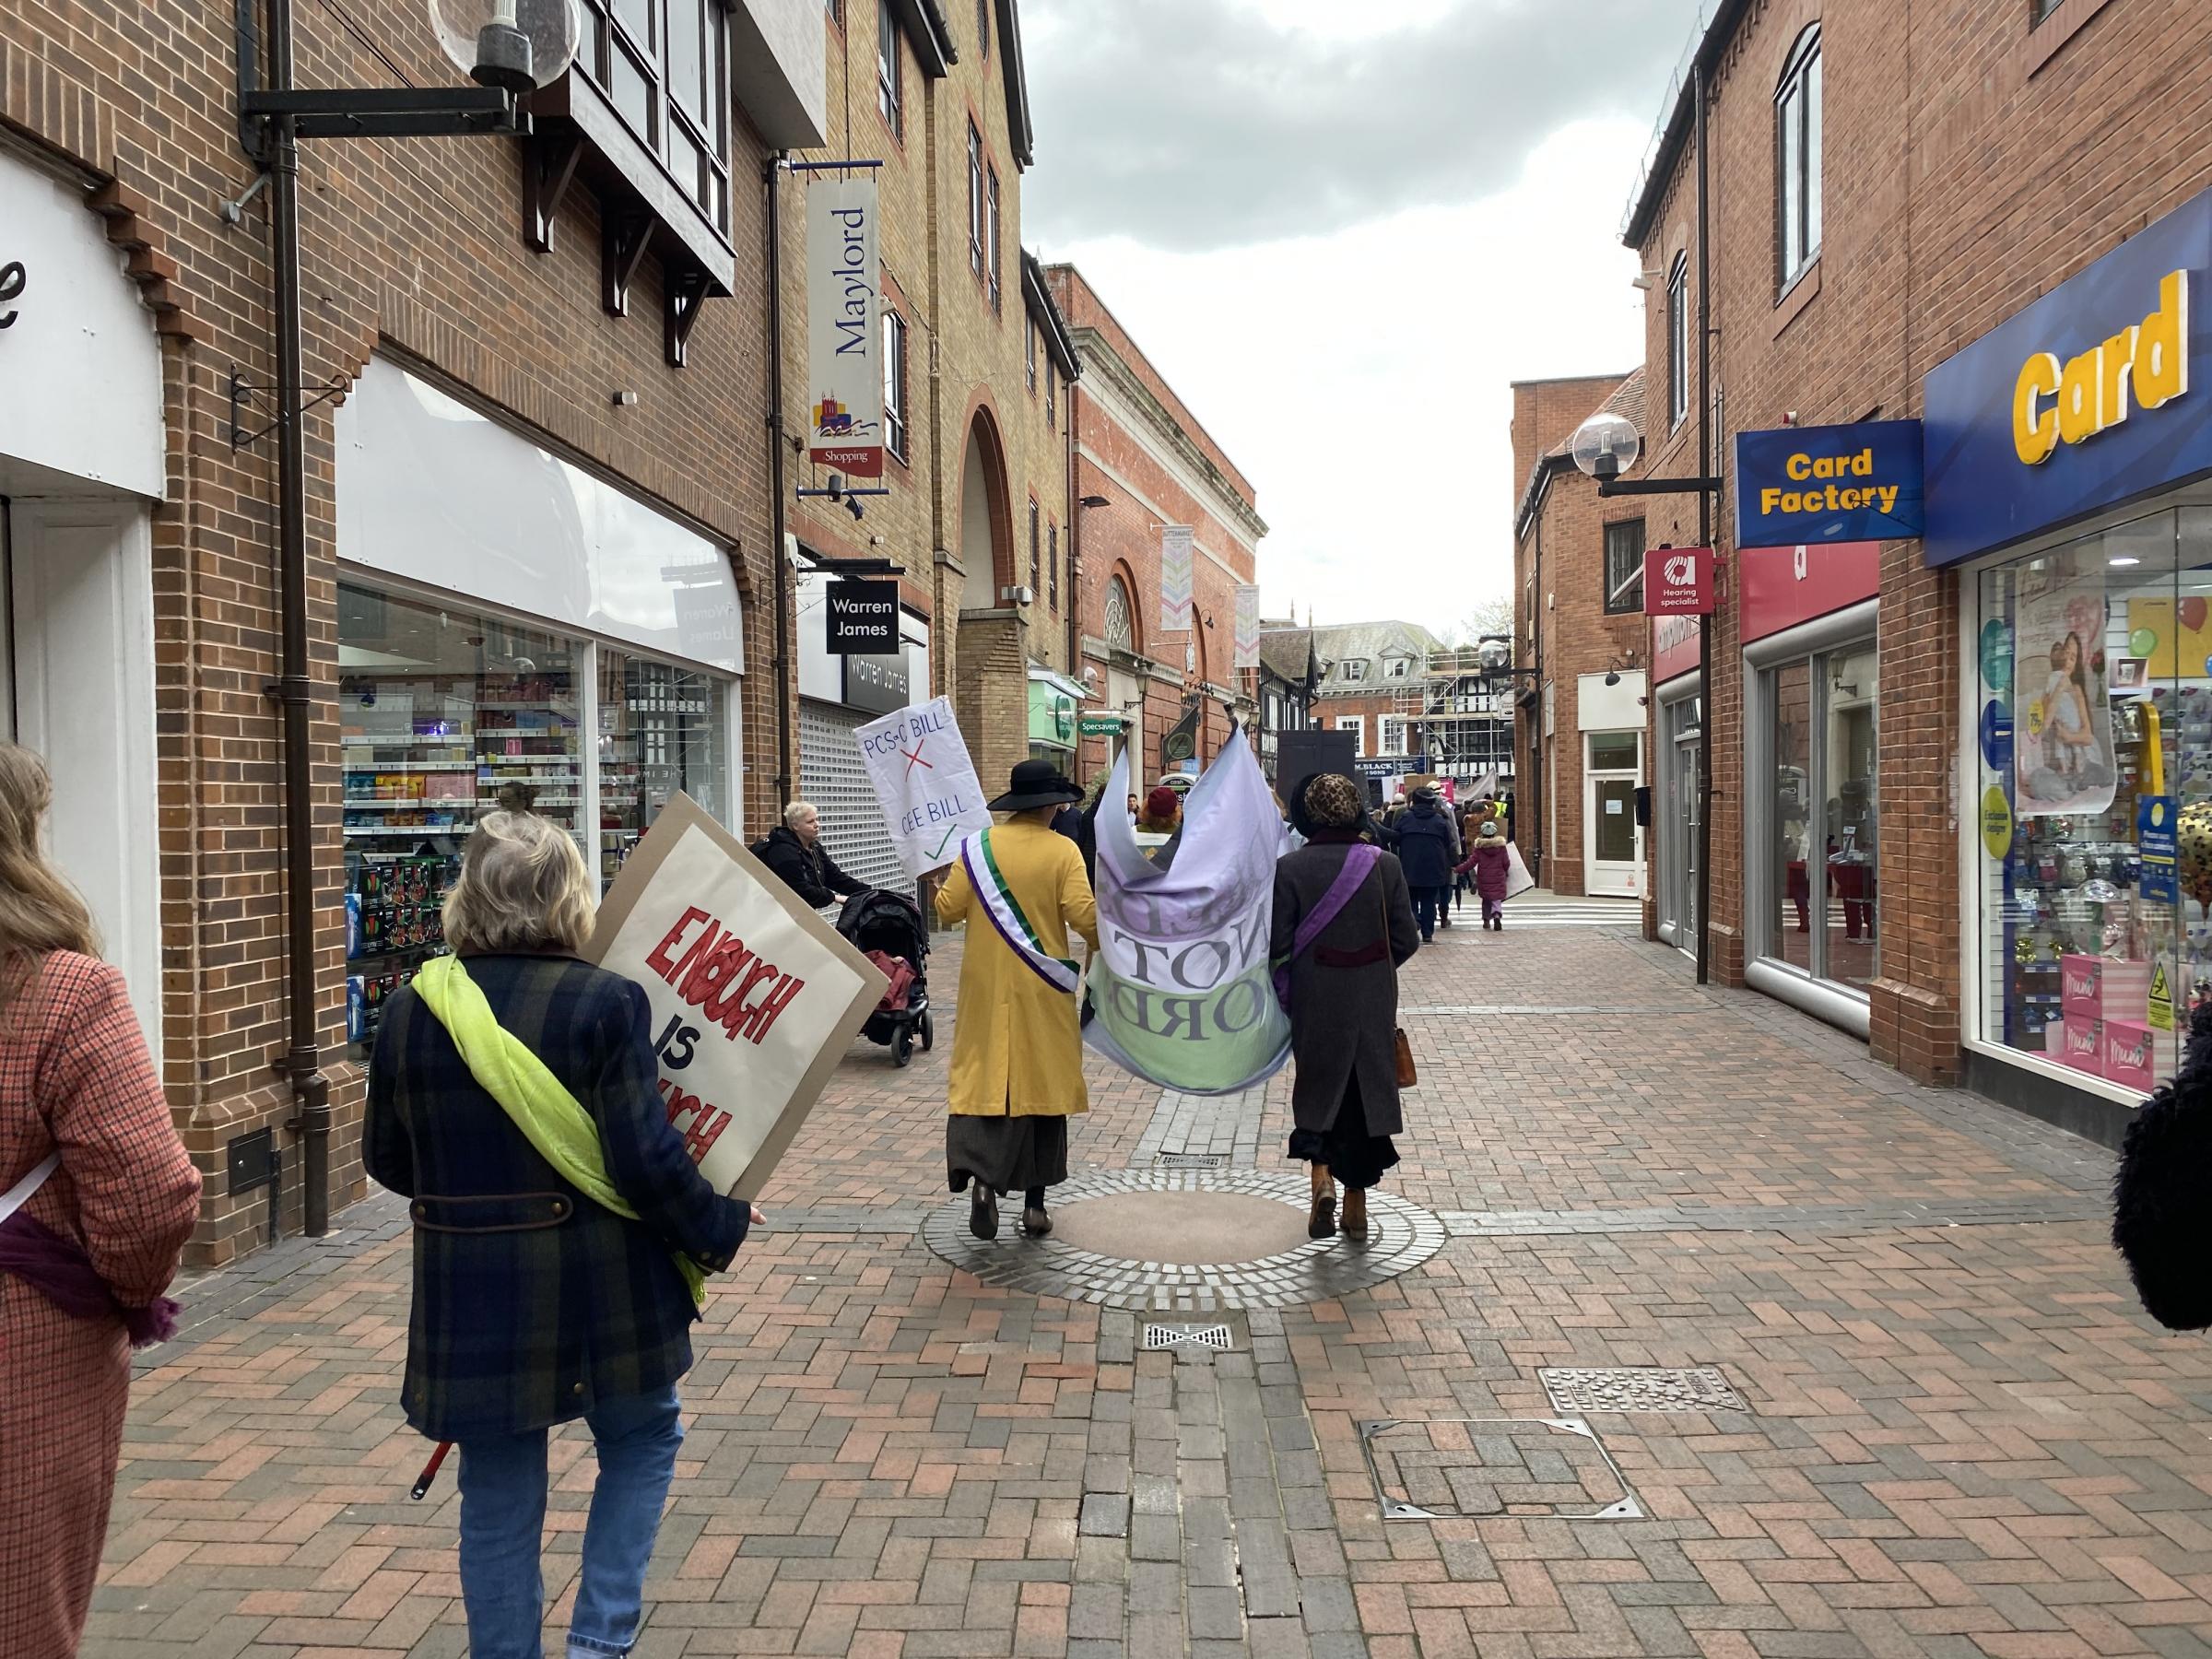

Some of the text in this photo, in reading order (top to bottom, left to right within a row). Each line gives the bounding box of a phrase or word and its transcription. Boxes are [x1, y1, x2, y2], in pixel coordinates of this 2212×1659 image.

[830, 206, 874, 359] Maylord
[2013, 268, 2189, 466] Card
[824, 450, 868, 464] Shopping
[1786, 448, 1873, 481] Card
[1761, 485, 1900, 516] Factory
[832, 598, 893, 615] Warren
[1661, 598, 1700, 607] specialist
[1663, 589, 1697, 598] Hearing
[837, 621, 888, 637] James
[852, 654, 907, 694] Warren James
[910, 712, 945, 738] BILL
[1082, 722, 1120, 732] Specsavers
[900, 794, 968, 836] CEE BILL
[645, 905, 805, 1045] ENOUGH
[653, 1014, 701, 1070] IS
